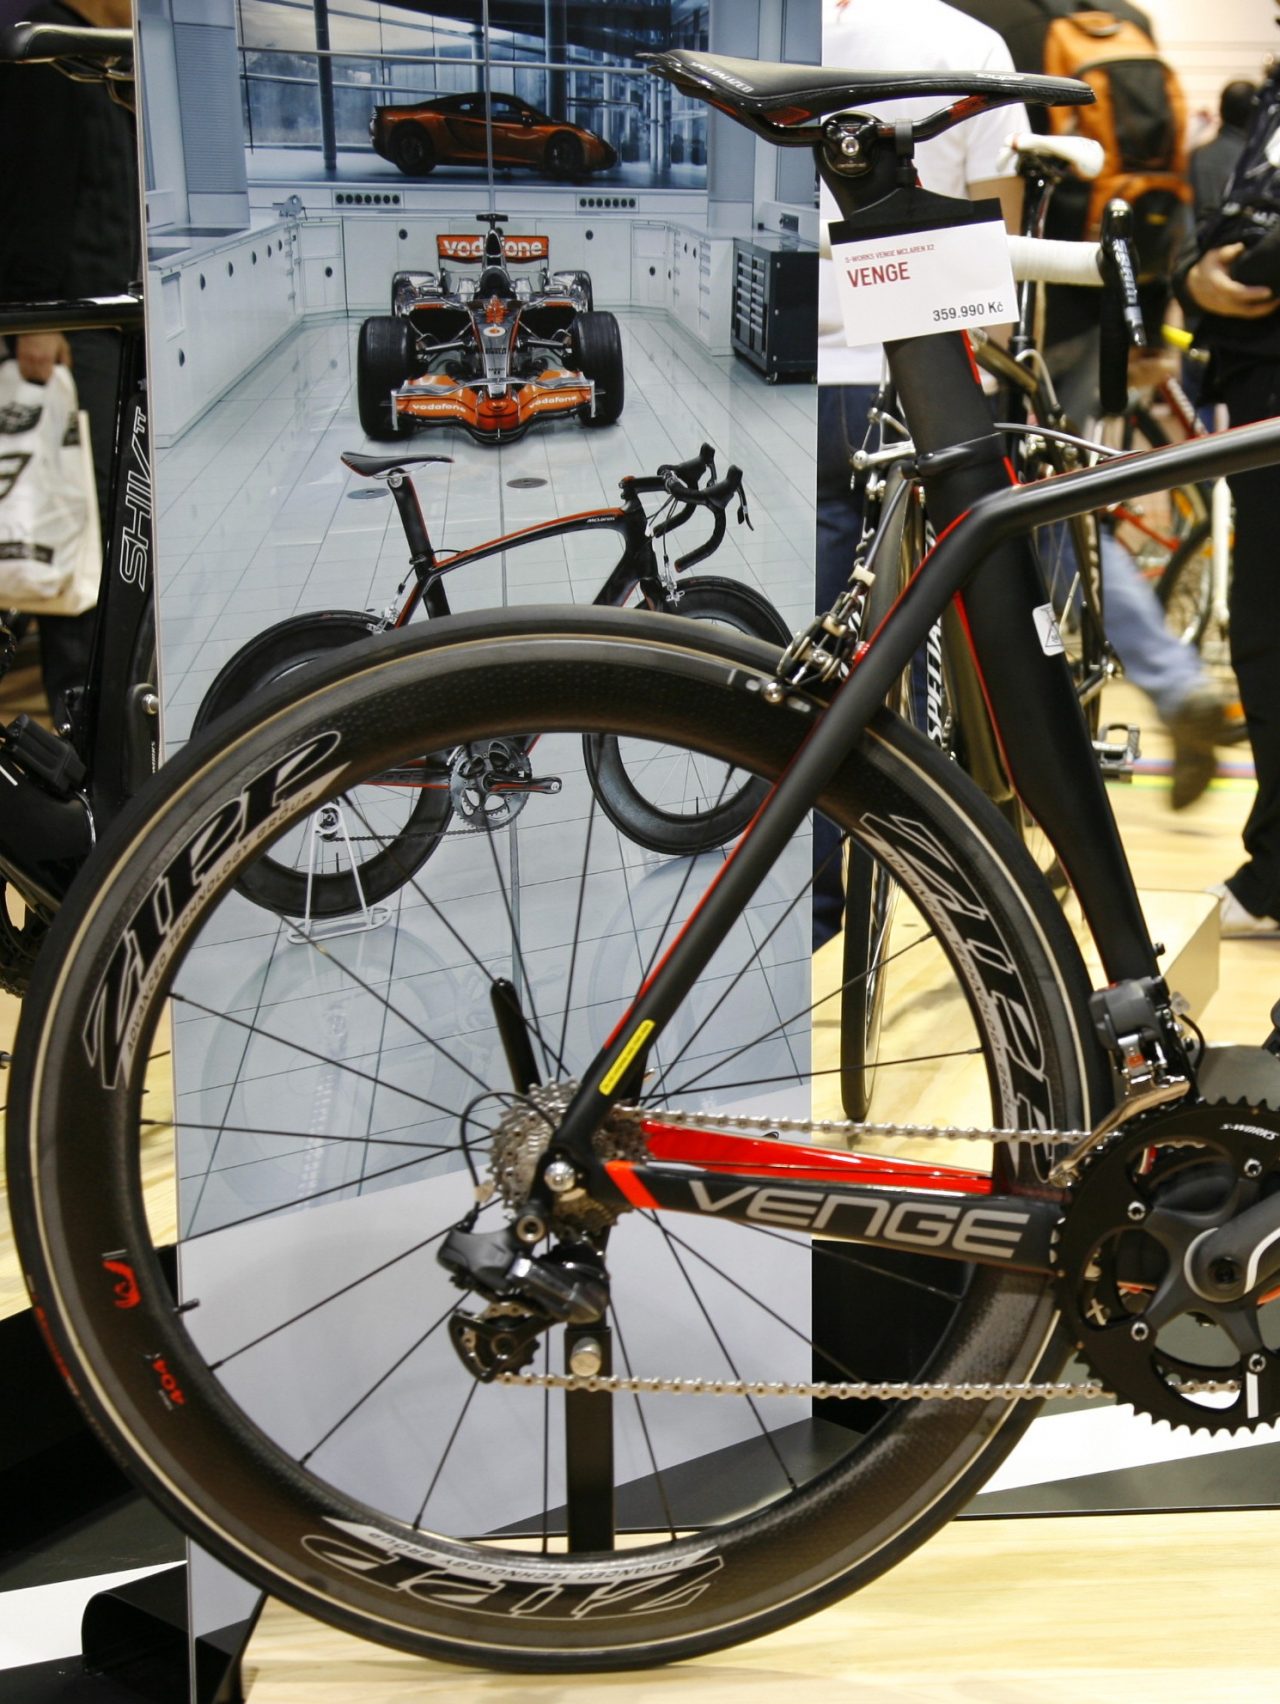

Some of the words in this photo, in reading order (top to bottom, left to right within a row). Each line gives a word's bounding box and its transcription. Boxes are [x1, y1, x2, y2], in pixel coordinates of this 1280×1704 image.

[444, 236, 543, 257] vodone
[876, 249, 897, 260] VENGE
[847, 261, 911, 288] VENGE
[932, 303, 985, 322] 359.990
[688, 1179, 1031, 1260] VENGE
